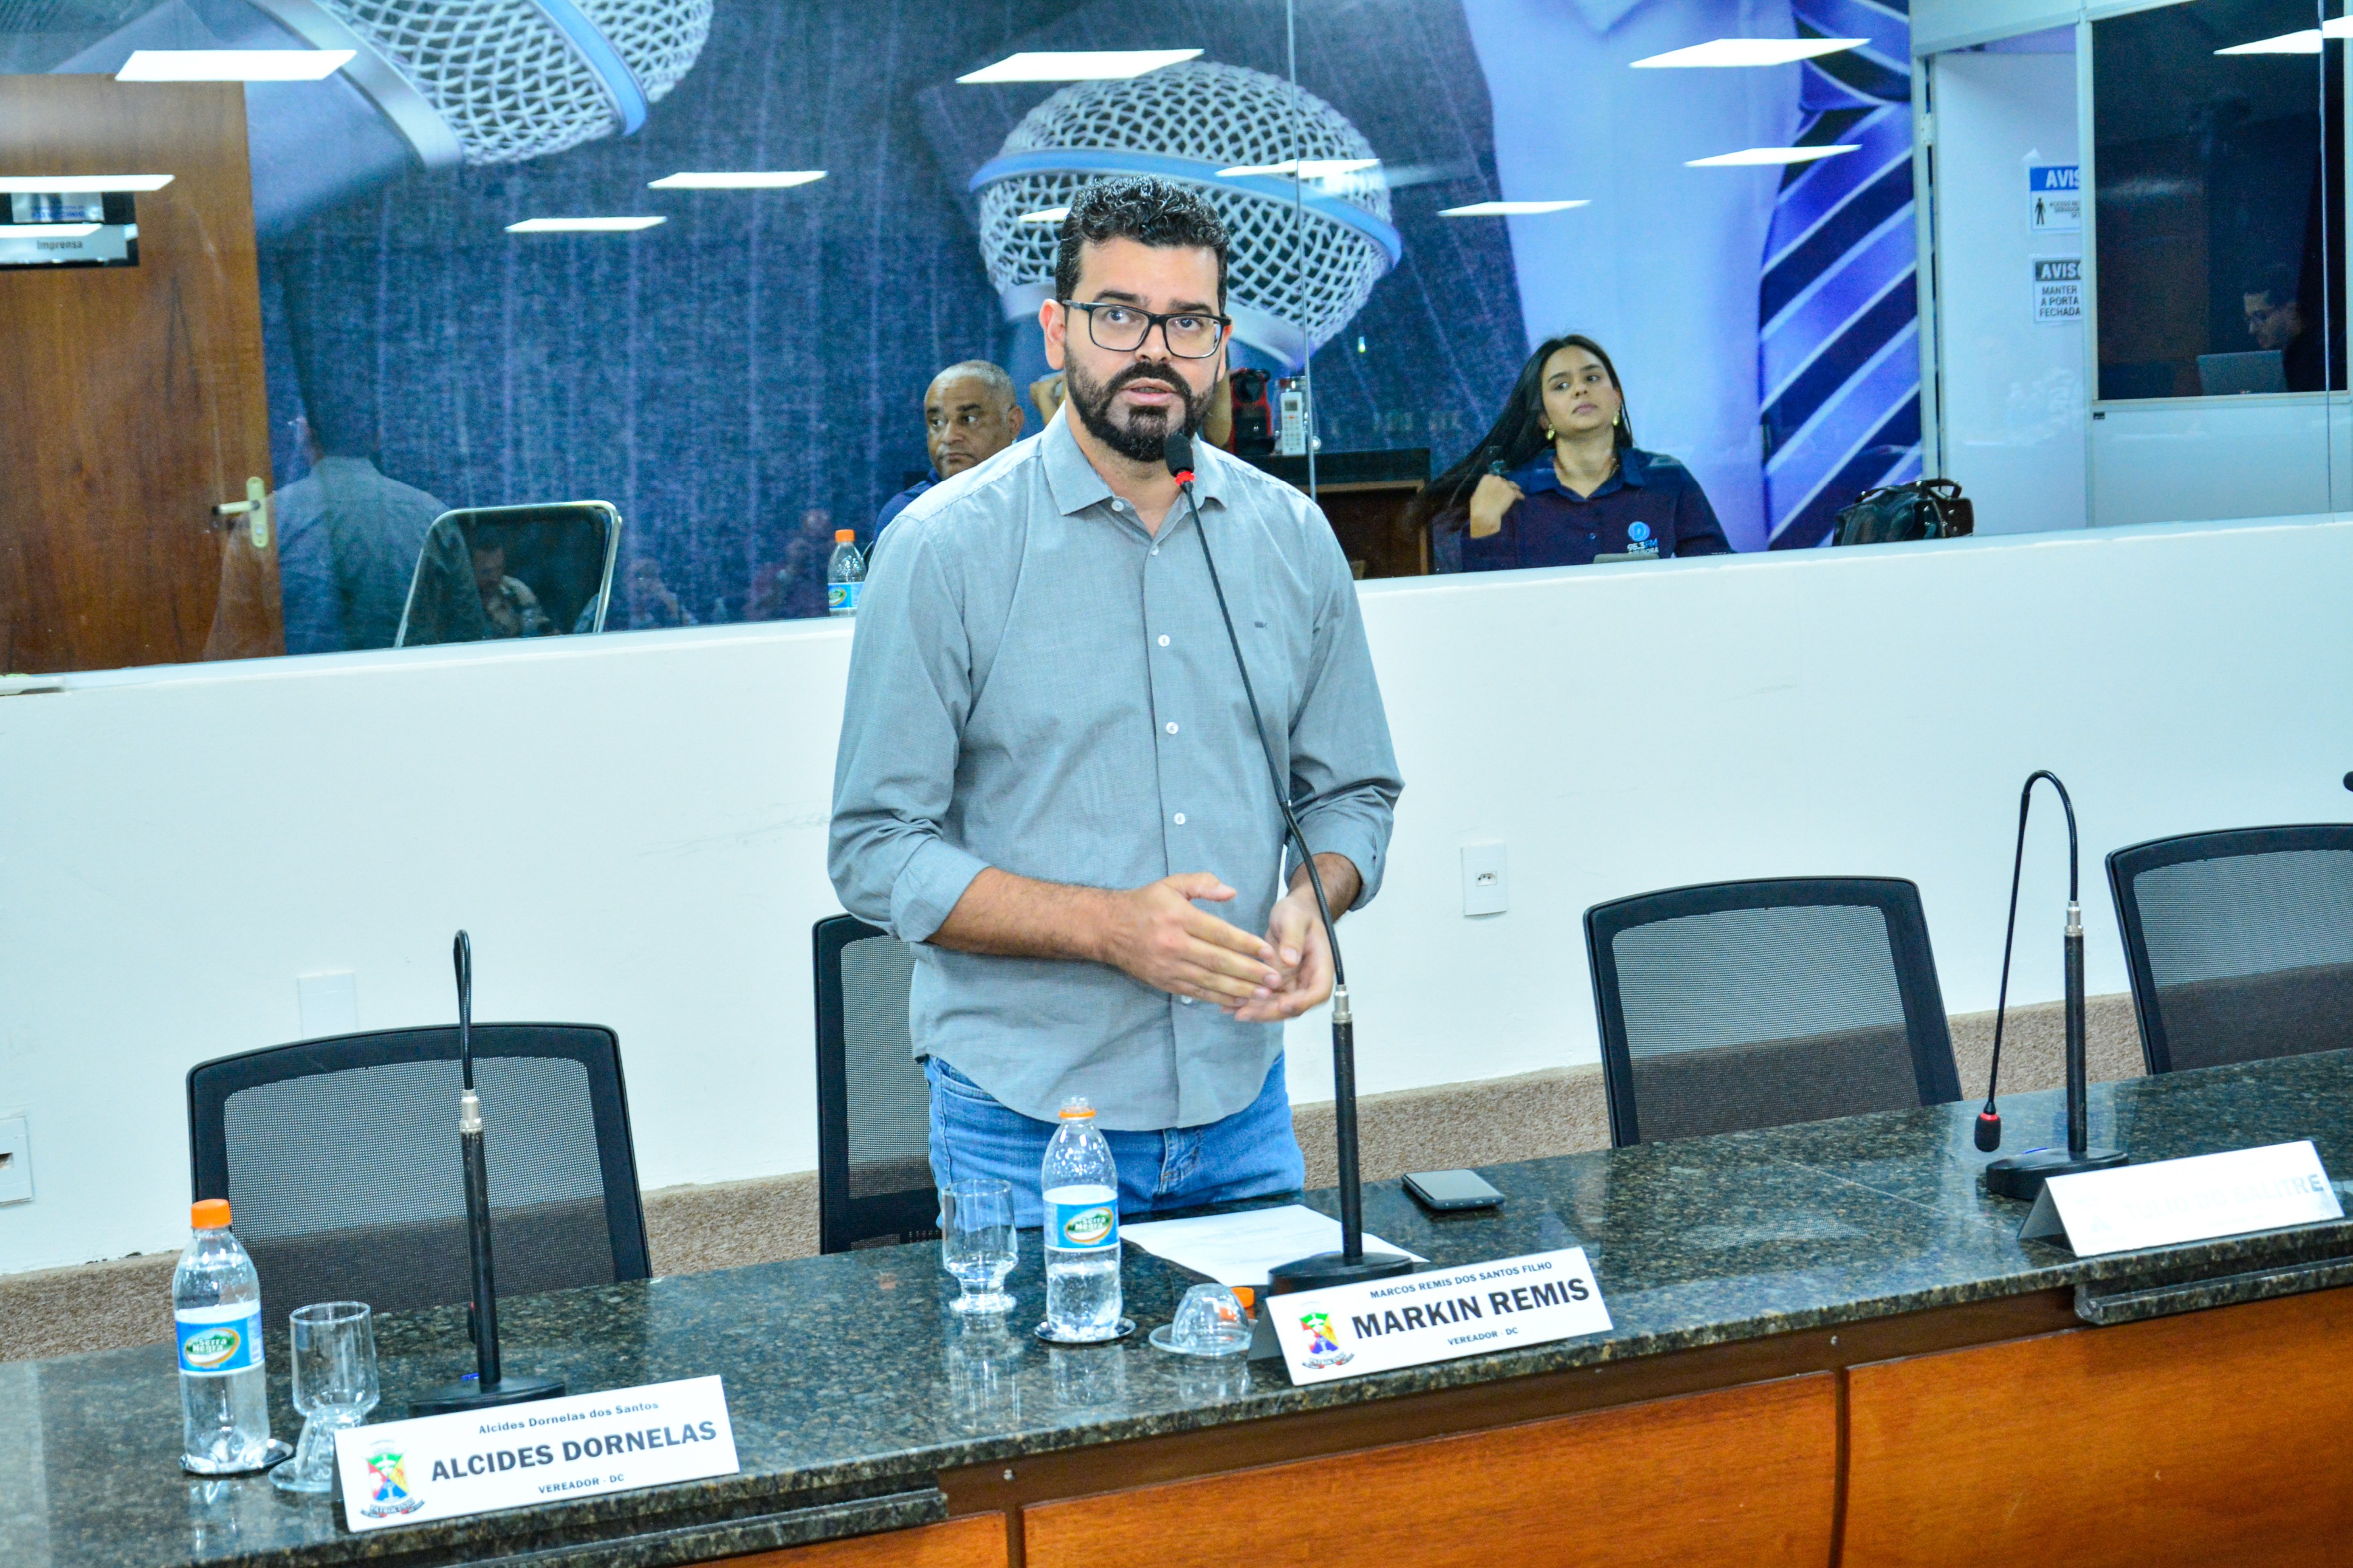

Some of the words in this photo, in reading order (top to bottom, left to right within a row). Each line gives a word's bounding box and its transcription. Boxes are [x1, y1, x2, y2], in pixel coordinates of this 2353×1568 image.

[2042, 285, 2077, 295] MANTER
[2041, 296, 2047, 306] A
[2050, 296, 2078, 306] PORTA
[2040, 307, 2081, 317] FECHADA
[1370, 1285, 1416, 1299] MARCOS
[1418, 1279, 1452, 1290] REMIS
[1455, 1275, 1477, 1285] DOS
[1479, 1267, 1520, 1280] SANTOS
[1522, 1262, 1552, 1273] FILHO
[1352, 1295, 1483, 1340] MARKIN
[1488, 1278, 1590, 1315] REMIS
[1447, 1330, 1498, 1346] VEREADOR
[1505, 1327, 1519, 1336] DC
[193, 1344, 223, 1353] Negra
[479, 1422, 525, 1434] Alcides
[529, 1413, 585, 1427] Dornelas
[589, 1409, 612, 1418] dos
[616, 1401, 659, 1414] Santos
[431, 1445, 554, 1482] ALCIDES
[562, 1421, 717, 1462] DORNELAS
[538, 1478, 600, 1494] VEREADOR
[610, 1474, 624, 1484] DC
